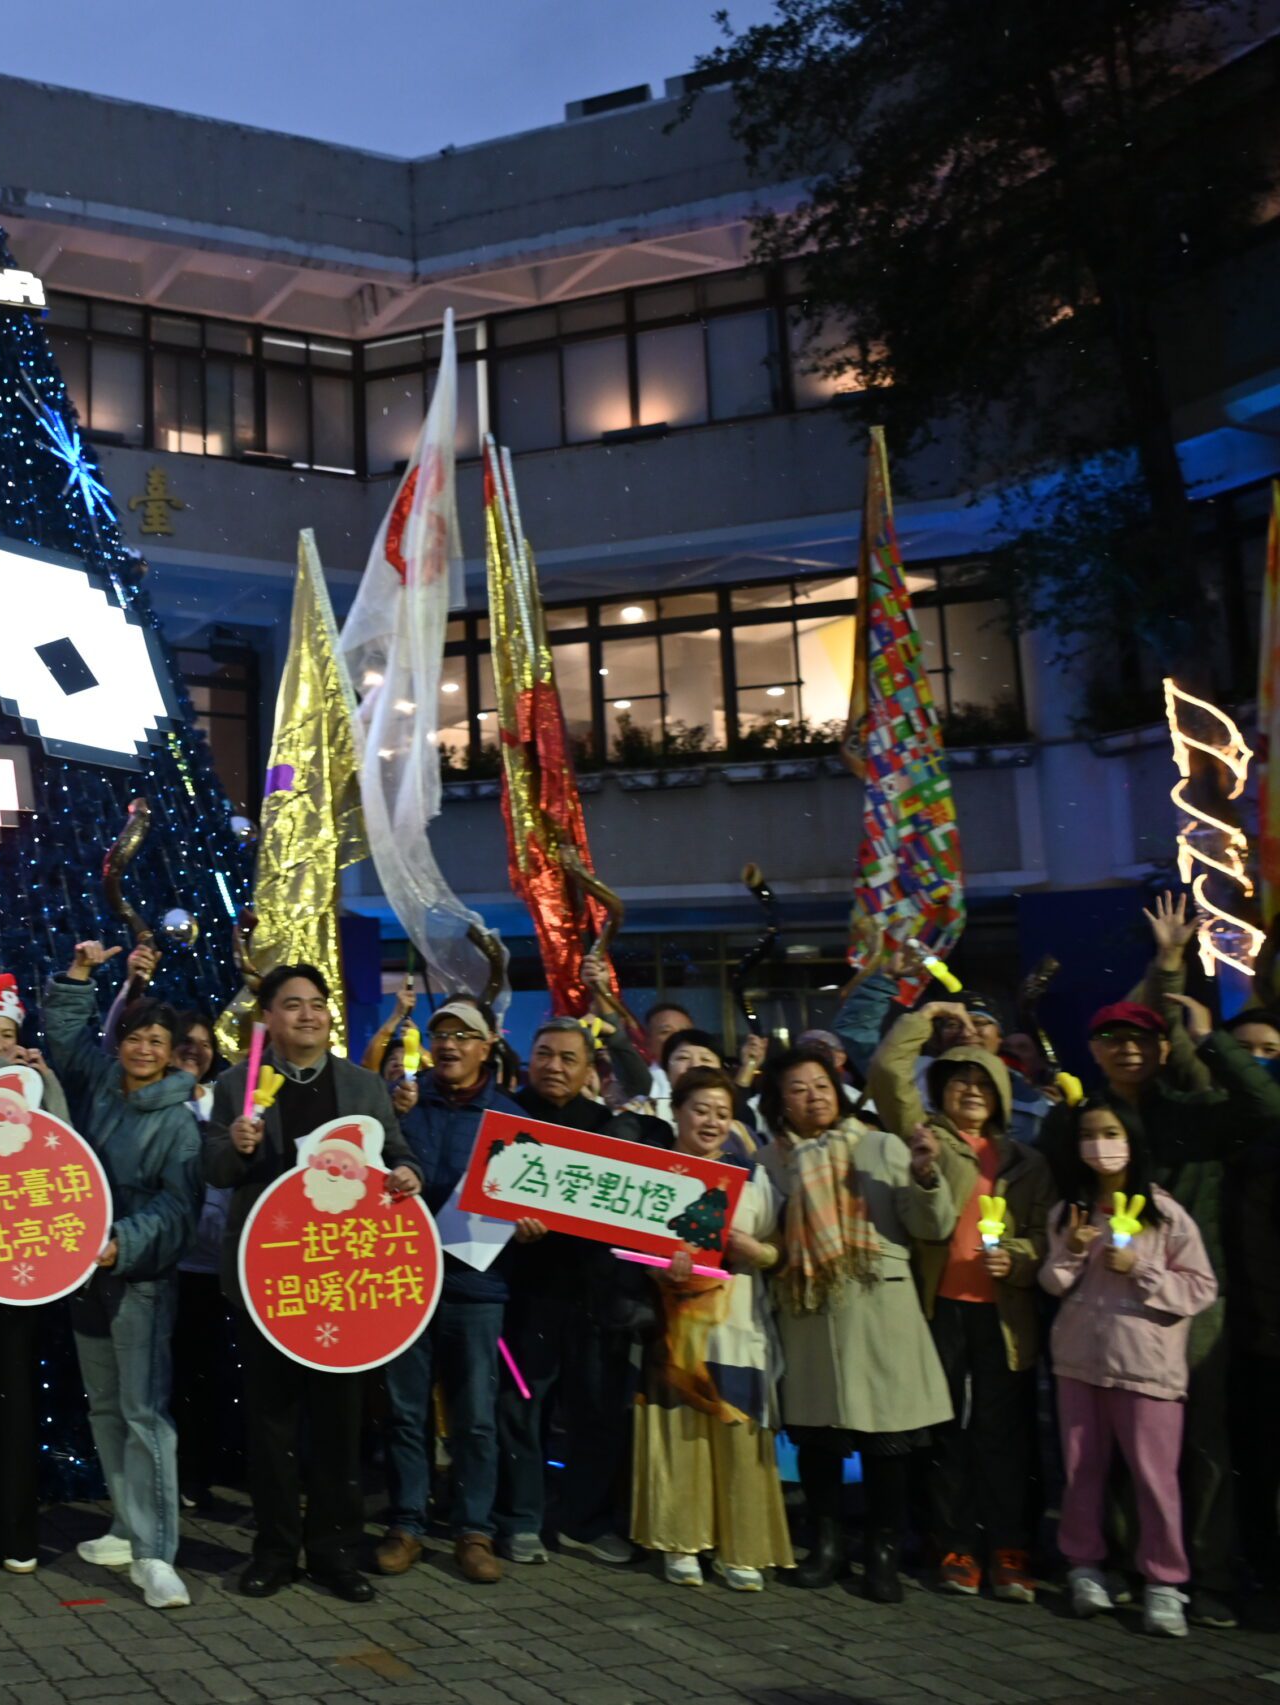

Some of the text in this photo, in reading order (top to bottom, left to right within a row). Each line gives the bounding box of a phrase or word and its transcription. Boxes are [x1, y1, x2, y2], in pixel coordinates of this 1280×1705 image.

[128, 466, 184, 534] 臺
[509, 1153, 678, 1224] 為愛點燈
[260, 1214, 420, 1263] 一起發光
[264, 1265, 425, 1319] 溫暖你我
